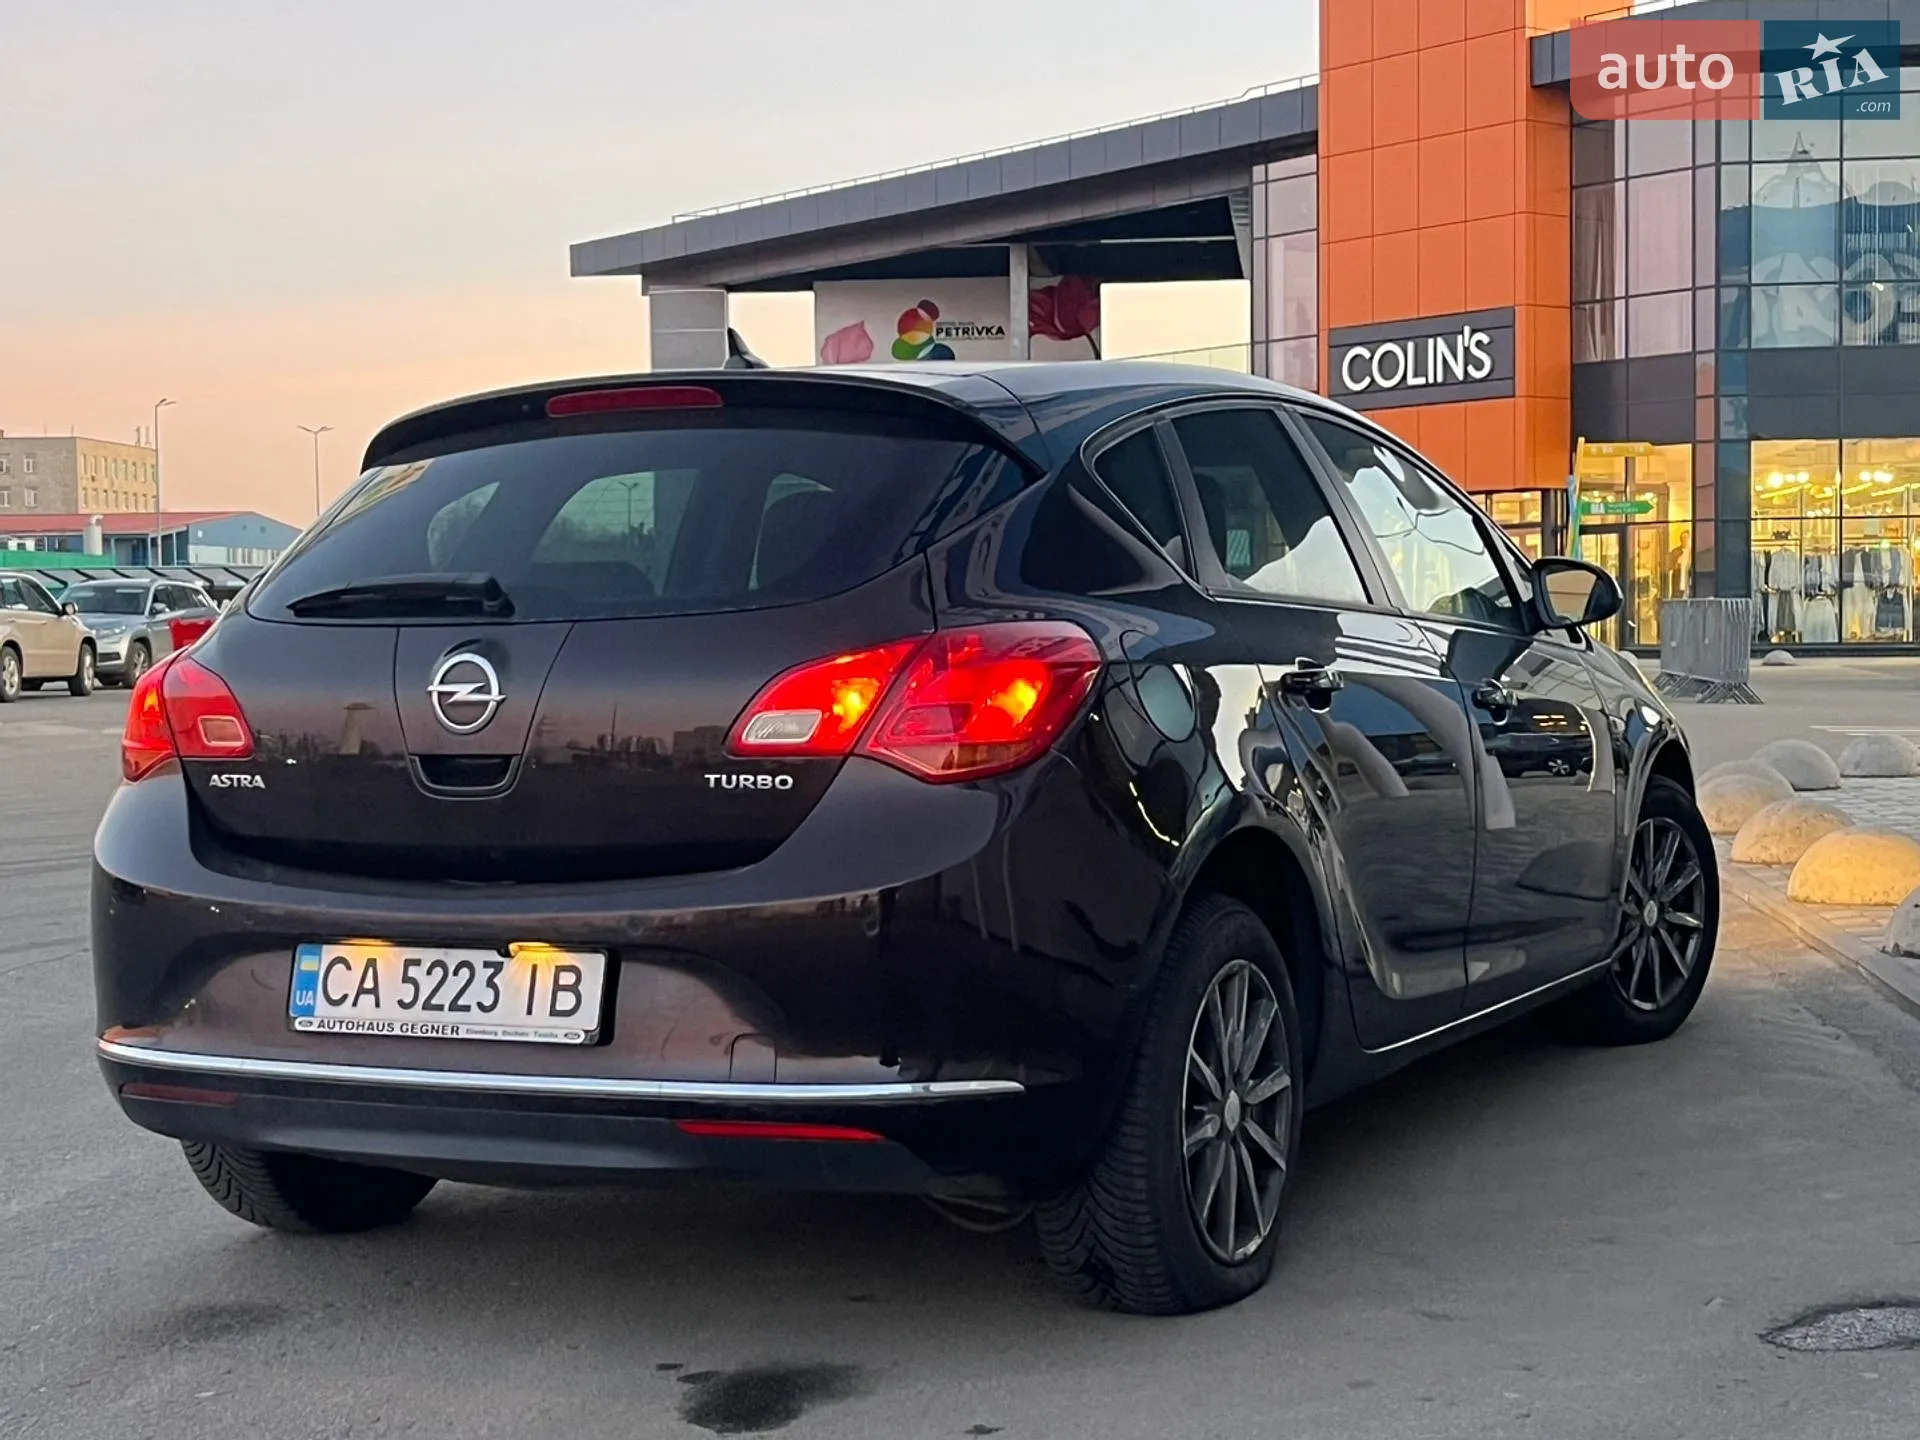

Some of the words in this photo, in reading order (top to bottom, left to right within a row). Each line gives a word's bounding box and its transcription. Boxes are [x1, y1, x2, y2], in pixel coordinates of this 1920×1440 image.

[1341, 326, 1493, 391] COLIN'S
[209, 773, 265, 789] ASTRA
[704, 773, 795, 791] TURBO
[322, 955, 381, 1009] CA
[397, 958, 504, 1014] 5223
[526, 963, 583, 1018] IB
[295, 990, 315, 1007] UA
[317, 1018, 395, 1033] AUTOHAUS
[399, 1022, 460, 1036] GEGNER
